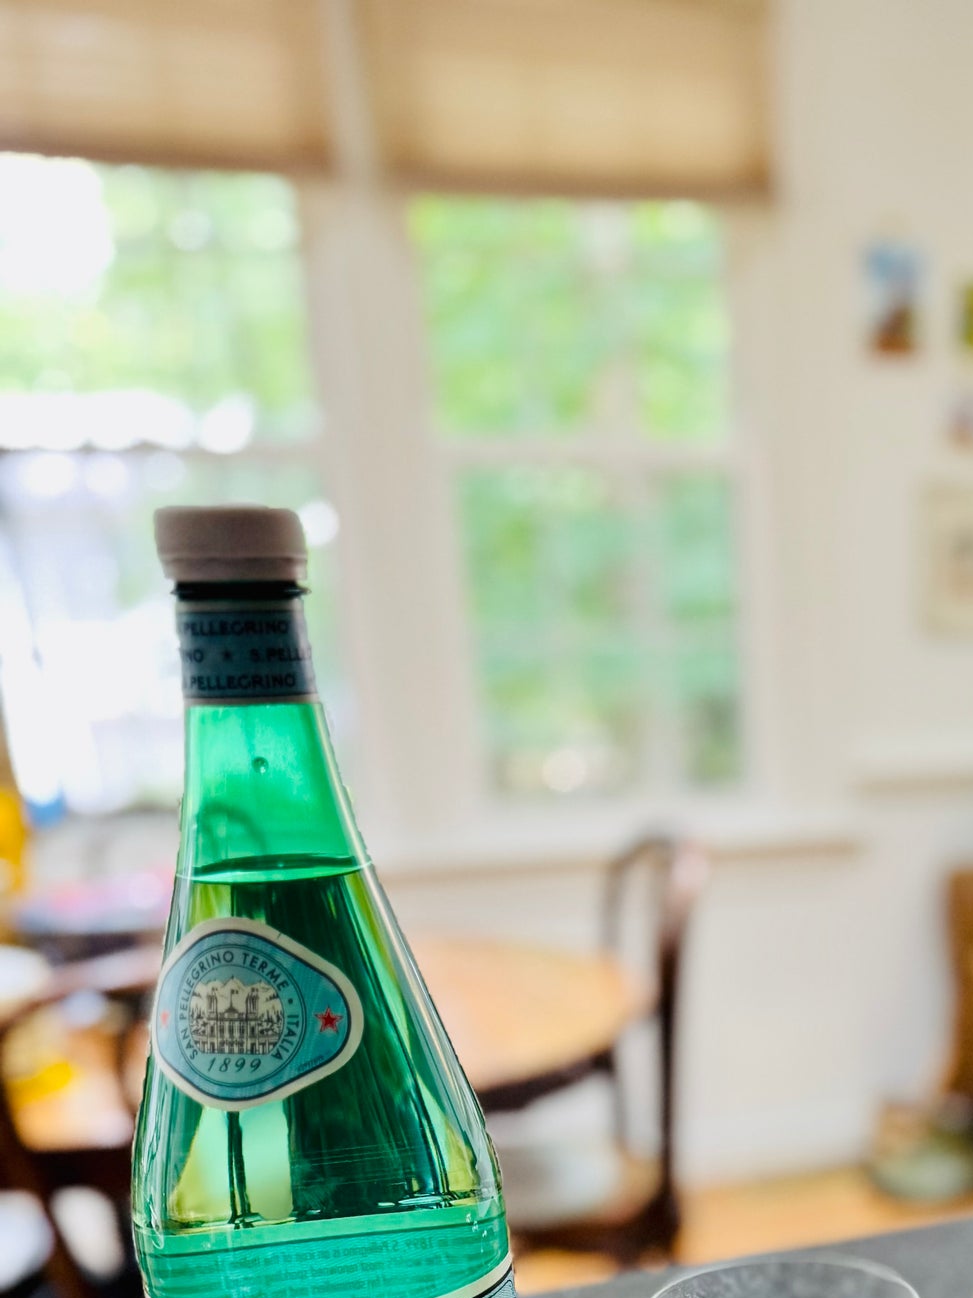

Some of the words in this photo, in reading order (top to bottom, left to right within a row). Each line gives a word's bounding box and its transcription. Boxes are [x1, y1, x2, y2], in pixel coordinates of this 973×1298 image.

[180, 951, 234, 1021] PELLEGRINO
[243, 953, 290, 991] TERME
[182, 1029, 198, 1060] SAN
[271, 1014, 300, 1061] ITALIA
[207, 1057, 262, 1073] 1899
